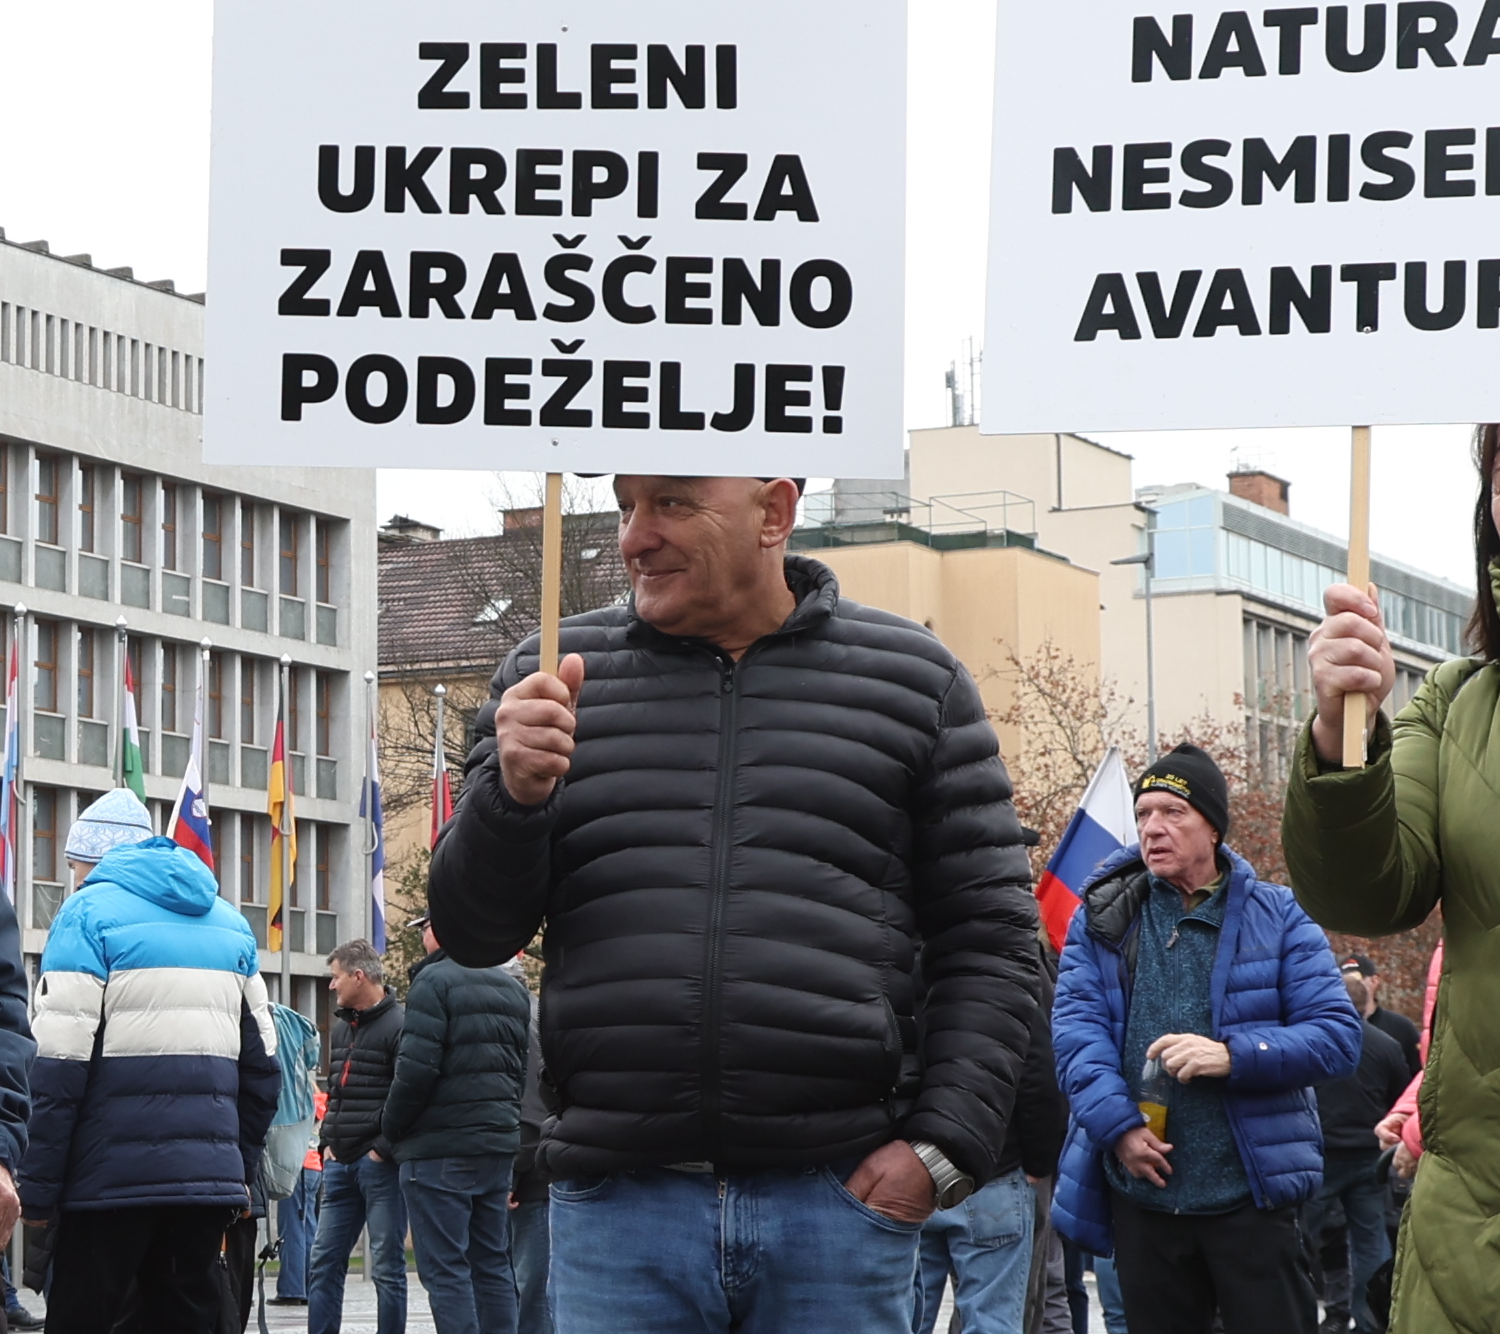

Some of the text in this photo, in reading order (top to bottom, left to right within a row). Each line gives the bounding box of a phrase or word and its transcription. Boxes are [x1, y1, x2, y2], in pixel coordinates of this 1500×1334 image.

[416, 41, 738, 111] ZELENI
[316, 143, 821, 224] UKREPI ZA
[276, 232, 854, 330] ZARAŠČENO
[279, 337, 847, 436] PODEŽELJE!
